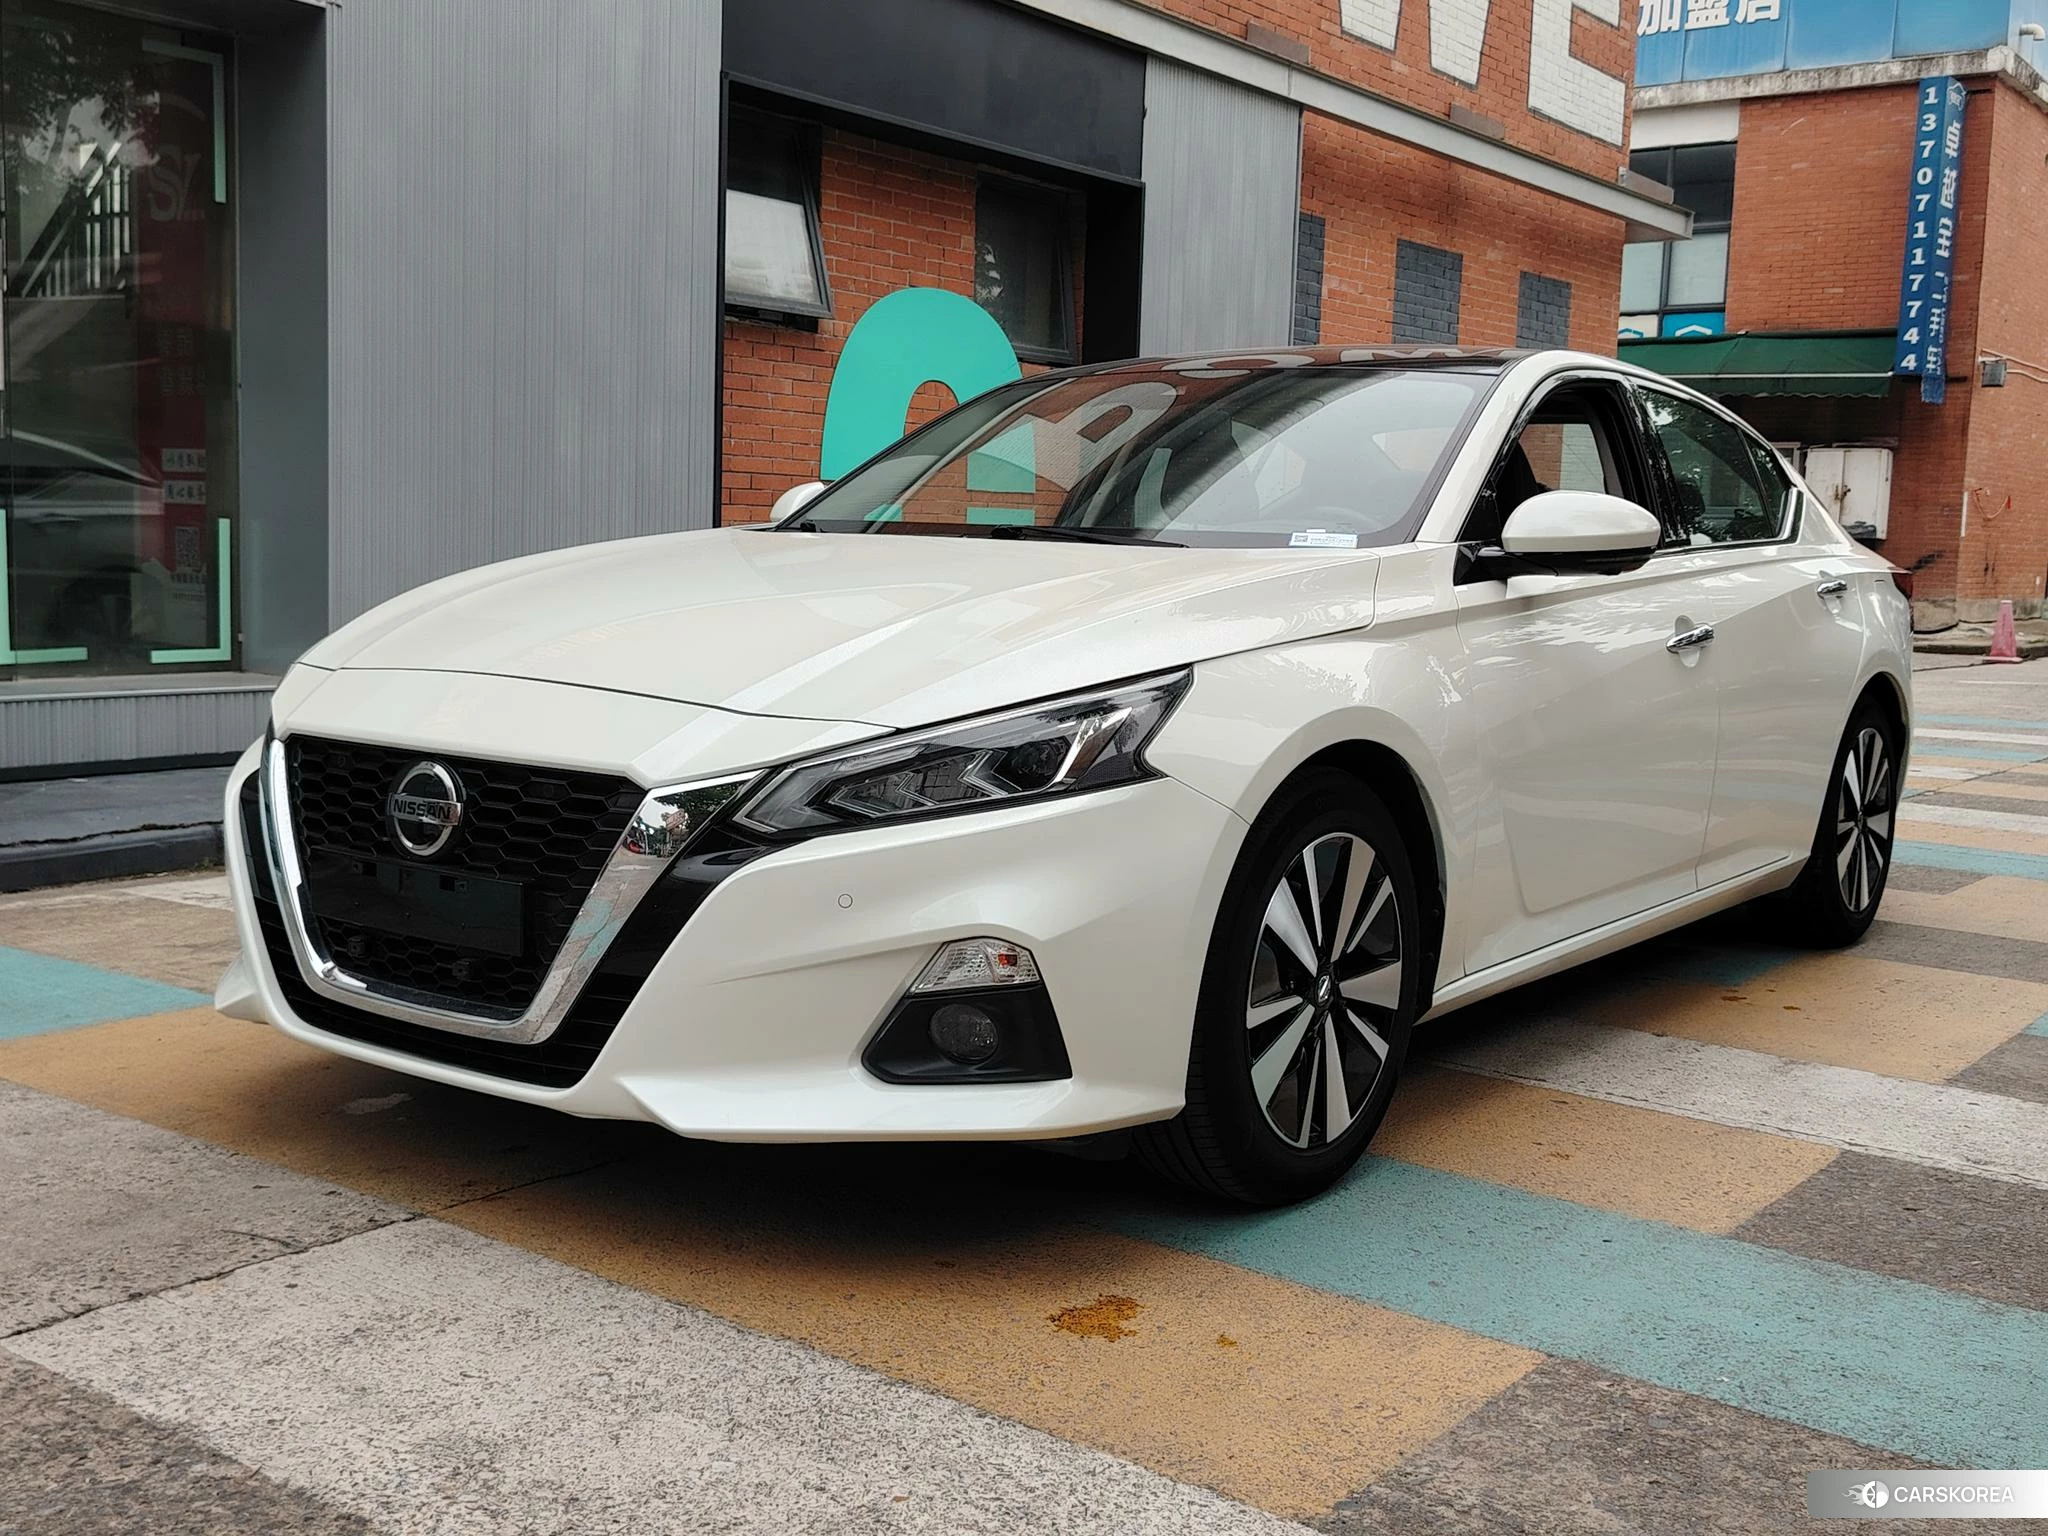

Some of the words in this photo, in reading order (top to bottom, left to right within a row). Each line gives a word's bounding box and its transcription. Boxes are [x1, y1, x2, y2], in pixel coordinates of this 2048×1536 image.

[1636, 0, 1780, 37] 加盟店
[1900, 86, 1939, 371] 13707117744
[393, 798, 452, 820] NISSAN
